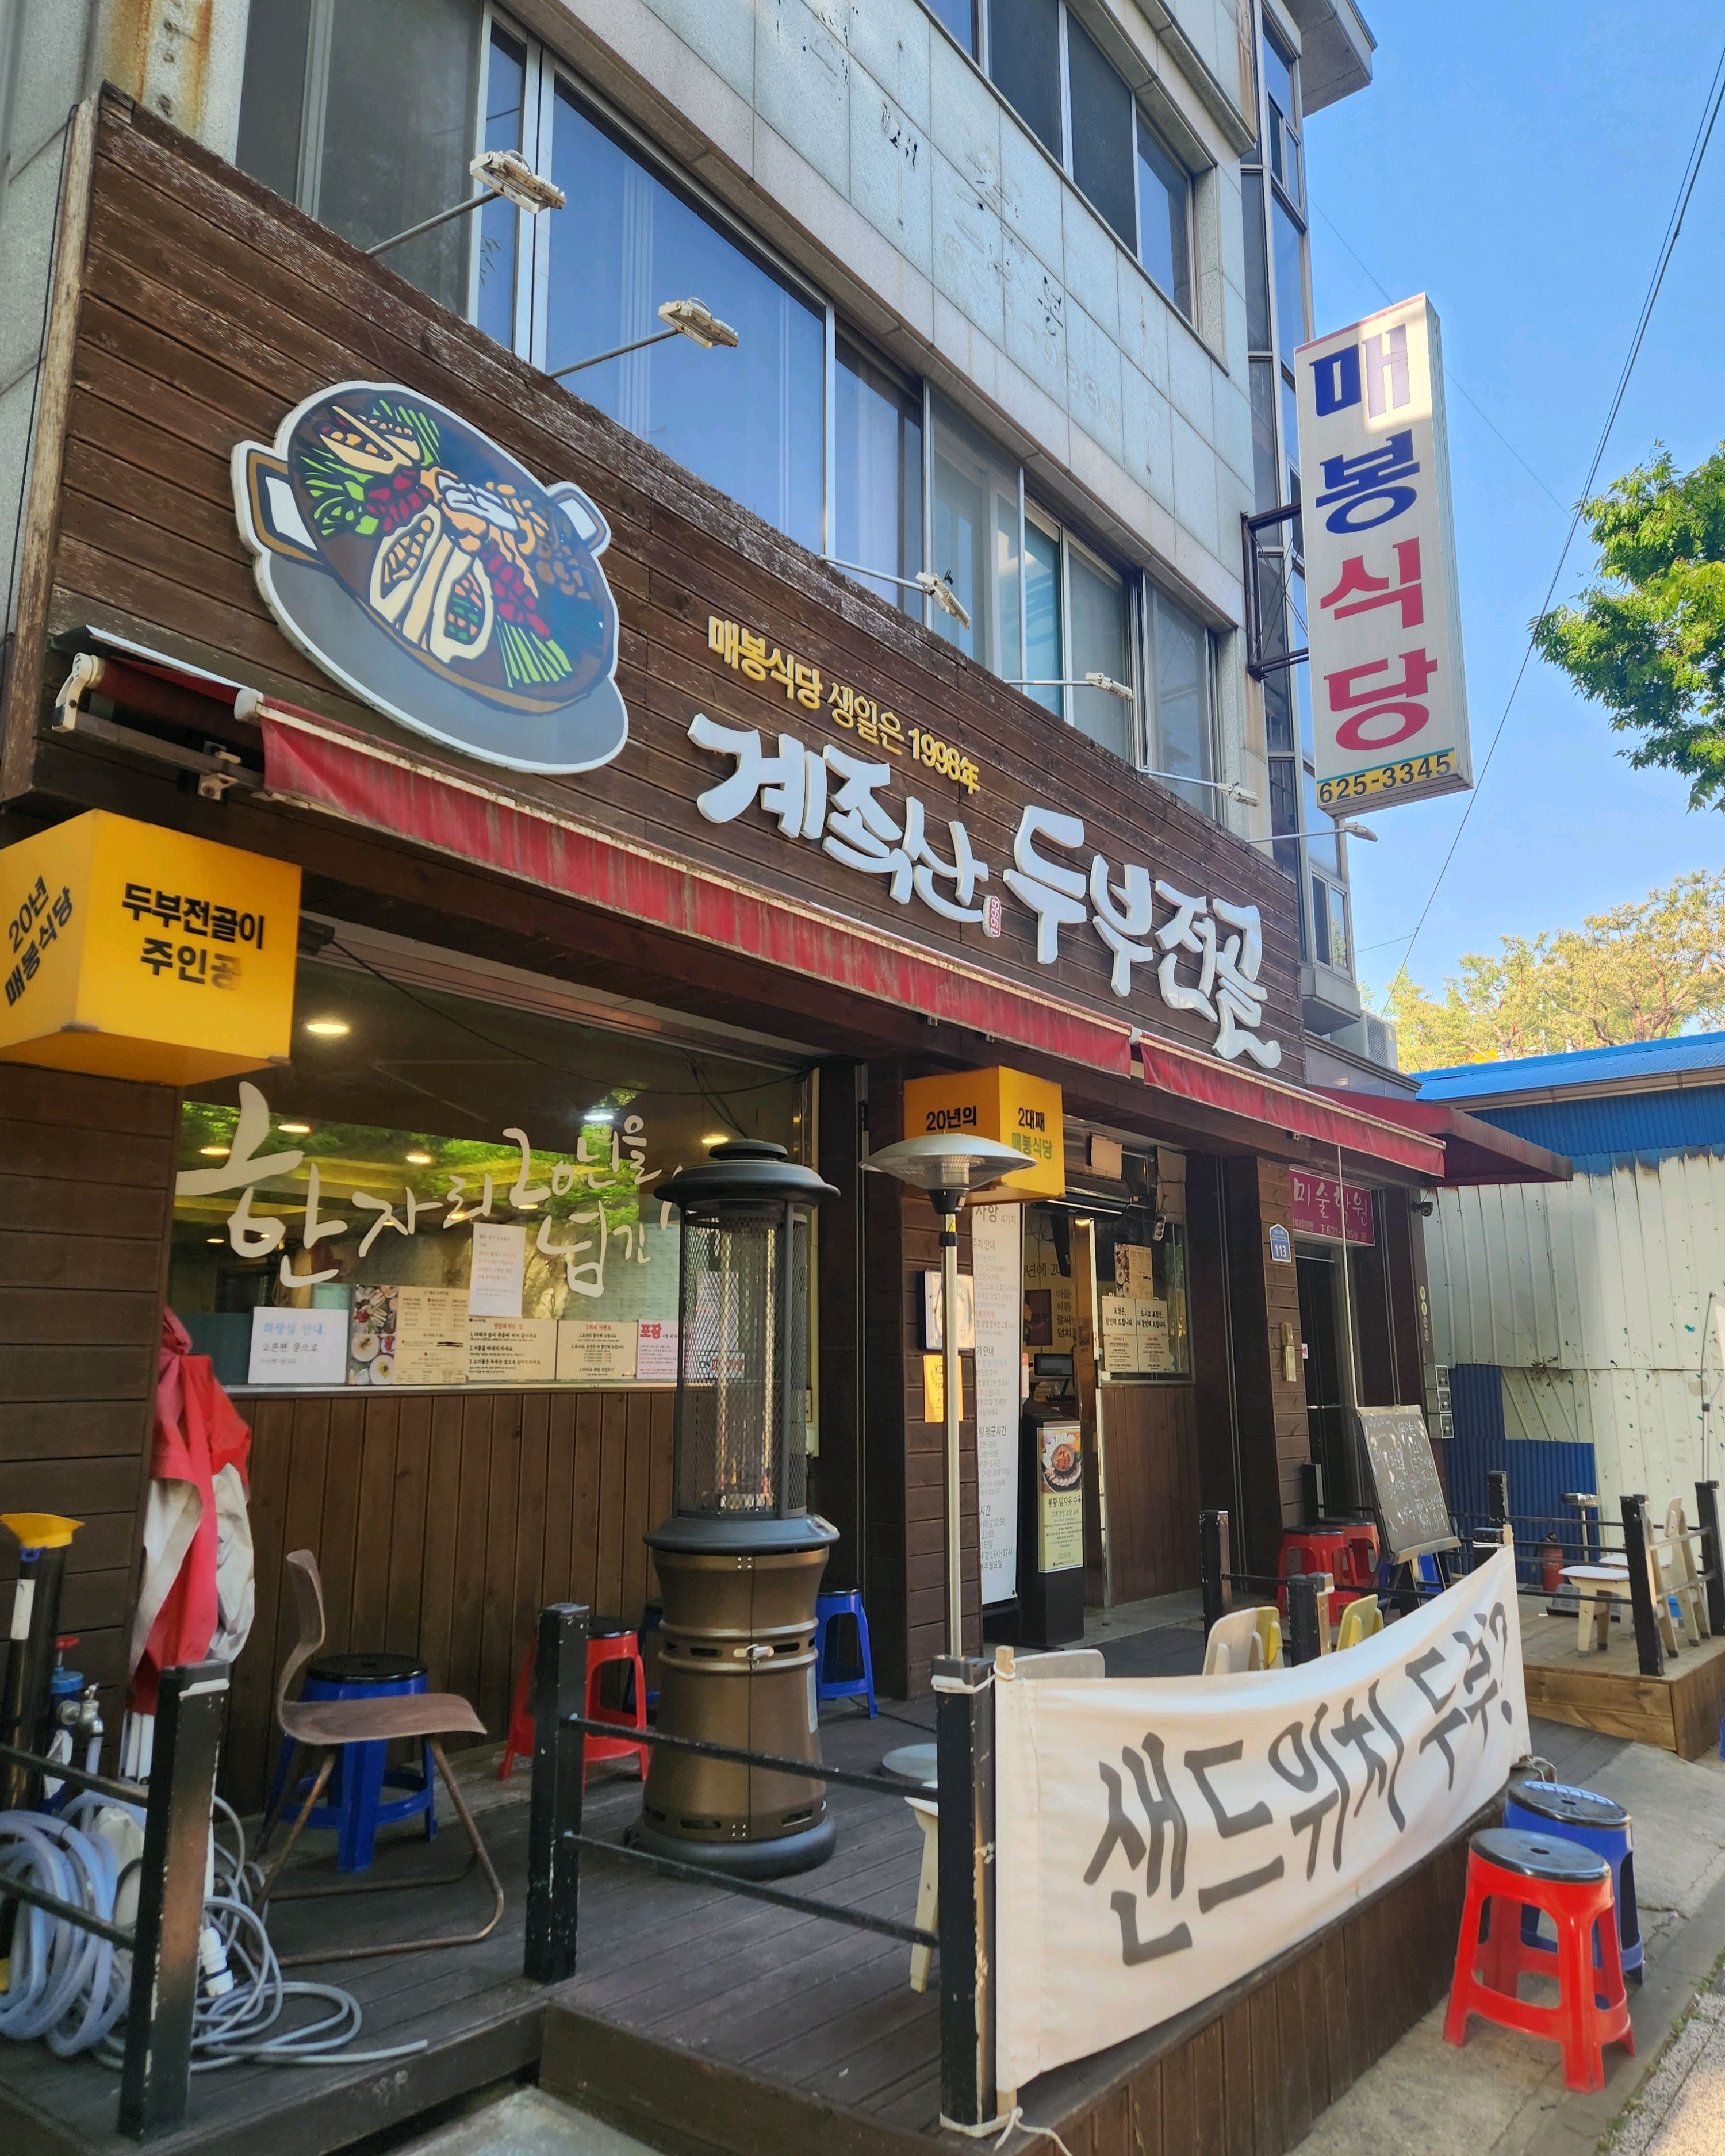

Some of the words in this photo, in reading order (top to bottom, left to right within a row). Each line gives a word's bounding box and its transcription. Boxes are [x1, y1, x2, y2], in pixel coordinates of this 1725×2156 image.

[1309, 324, 1438, 750] 매봉식당
[709, 616, 823, 709] 매봉식당
[827, 682, 904, 755] 생일은
[908, 728, 980, 795] 1998年
[1320, 753, 1452, 804] 625-3345
[7, 876, 51, 953] 20년
[687, 713, 989, 923] 계족산
[1003, 805, 1282, 1069] 두부전골
[122, 883, 264, 950] 두부전골이
[990, 899, 1002, 937] 1998
[4, 886, 74, 1007] 매봉식당
[140, 937, 242, 991] 주인공
[926, 1105, 977, 1131] 20년의
[1018, 1107, 1045, 1133] 2대째
[1011, 1132, 1053, 1160] 매봉식당
[1294, 1177, 1367, 1227] 미술학원
[984, 1238, 996, 1250] 안내
[1275, 1244, 1287, 1257] 113
[1320, 1223, 1358, 1240] T.621-359
[640, 1323, 662, 1340] 포장
[983, 1346, 994, 1357] 안내
[1083, 1679, 1406, 1967] 샌드위치
[1405, 1601, 1513, 1792] 두부?
